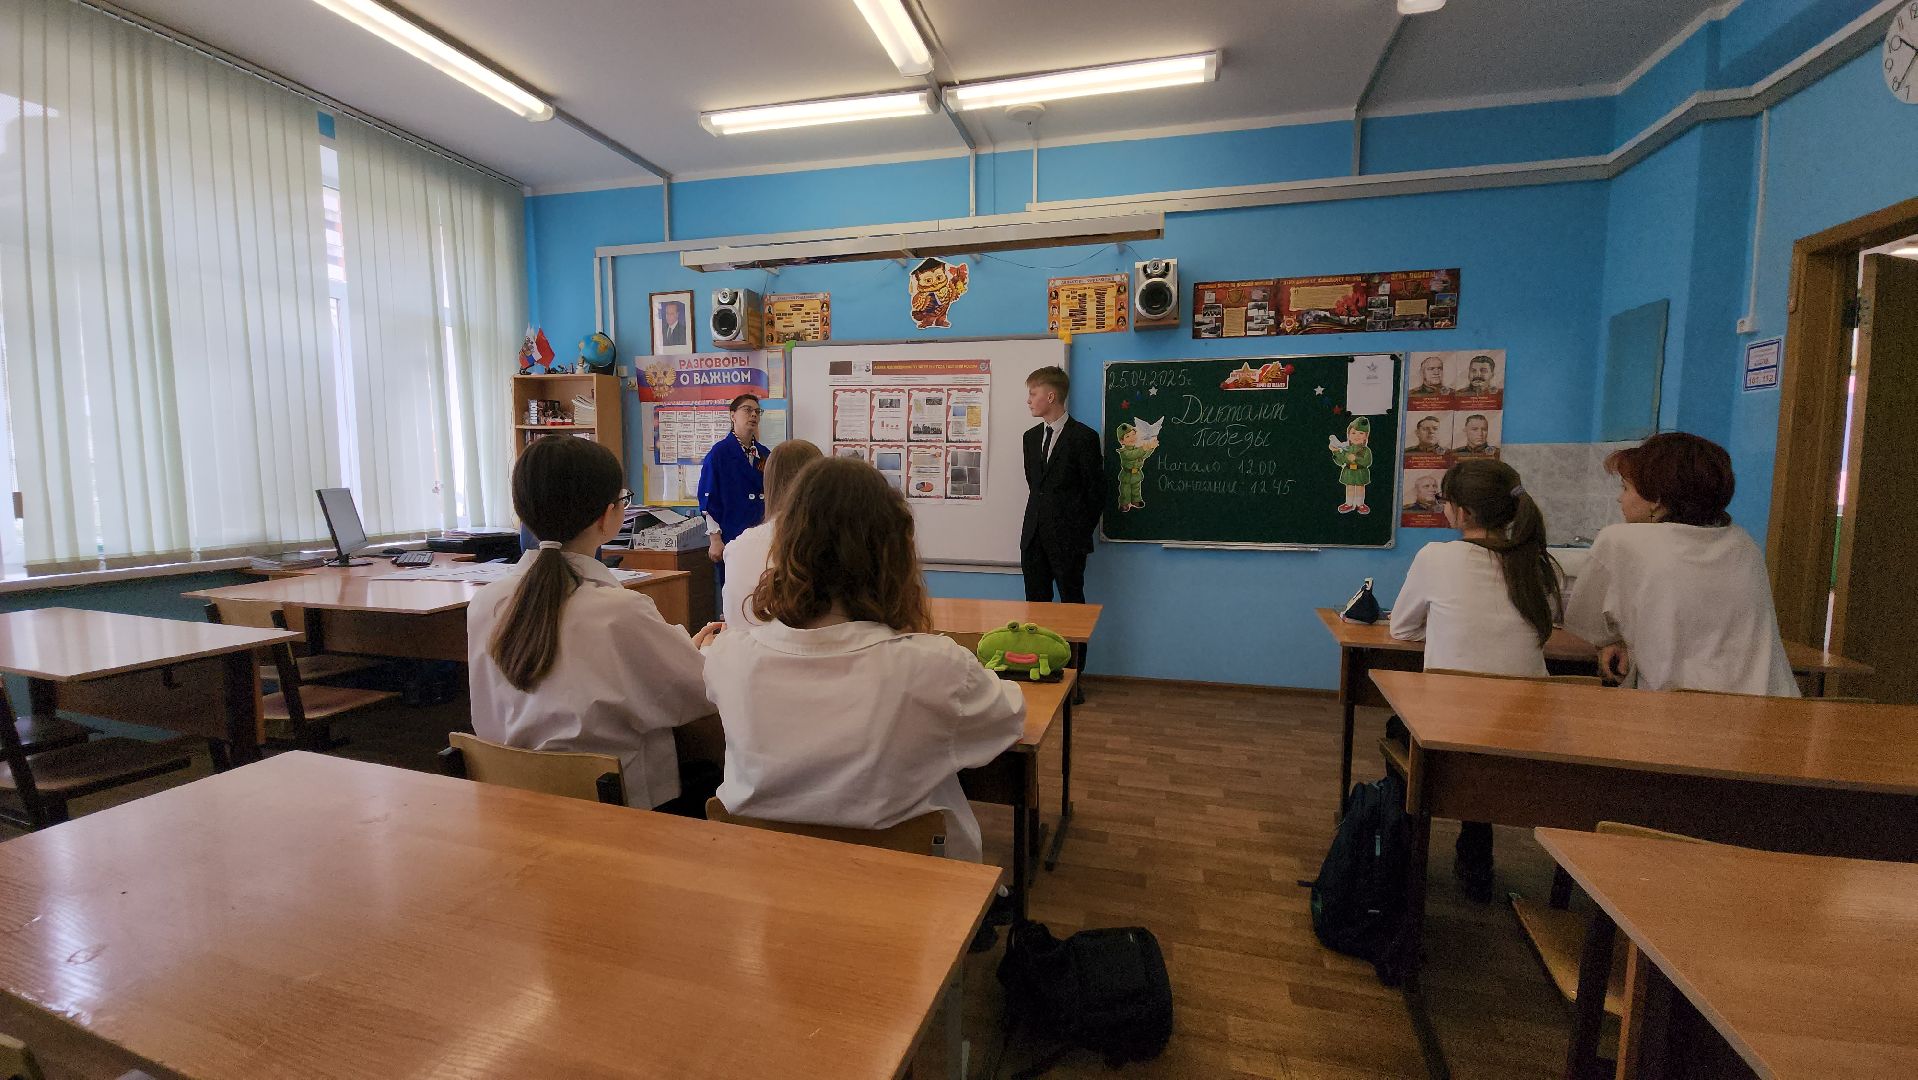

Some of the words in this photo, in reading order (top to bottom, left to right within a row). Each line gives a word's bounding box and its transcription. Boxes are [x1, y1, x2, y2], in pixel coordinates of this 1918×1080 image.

[1887, 35, 1902, 53] 10
[1885, 58, 1893, 73] 9
[1892, 76, 1900, 92] 8
[1905, 85, 1911, 101] 7
[679, 356, 750, 369] РАЗГОВОРЫ
[680, 373, 689, 385] О
[694, 370, 751, 384] ВАЖНОМ
[1171, 394, 1288, 425] Диктант
[1192, 424, 1272, 458] Победы
